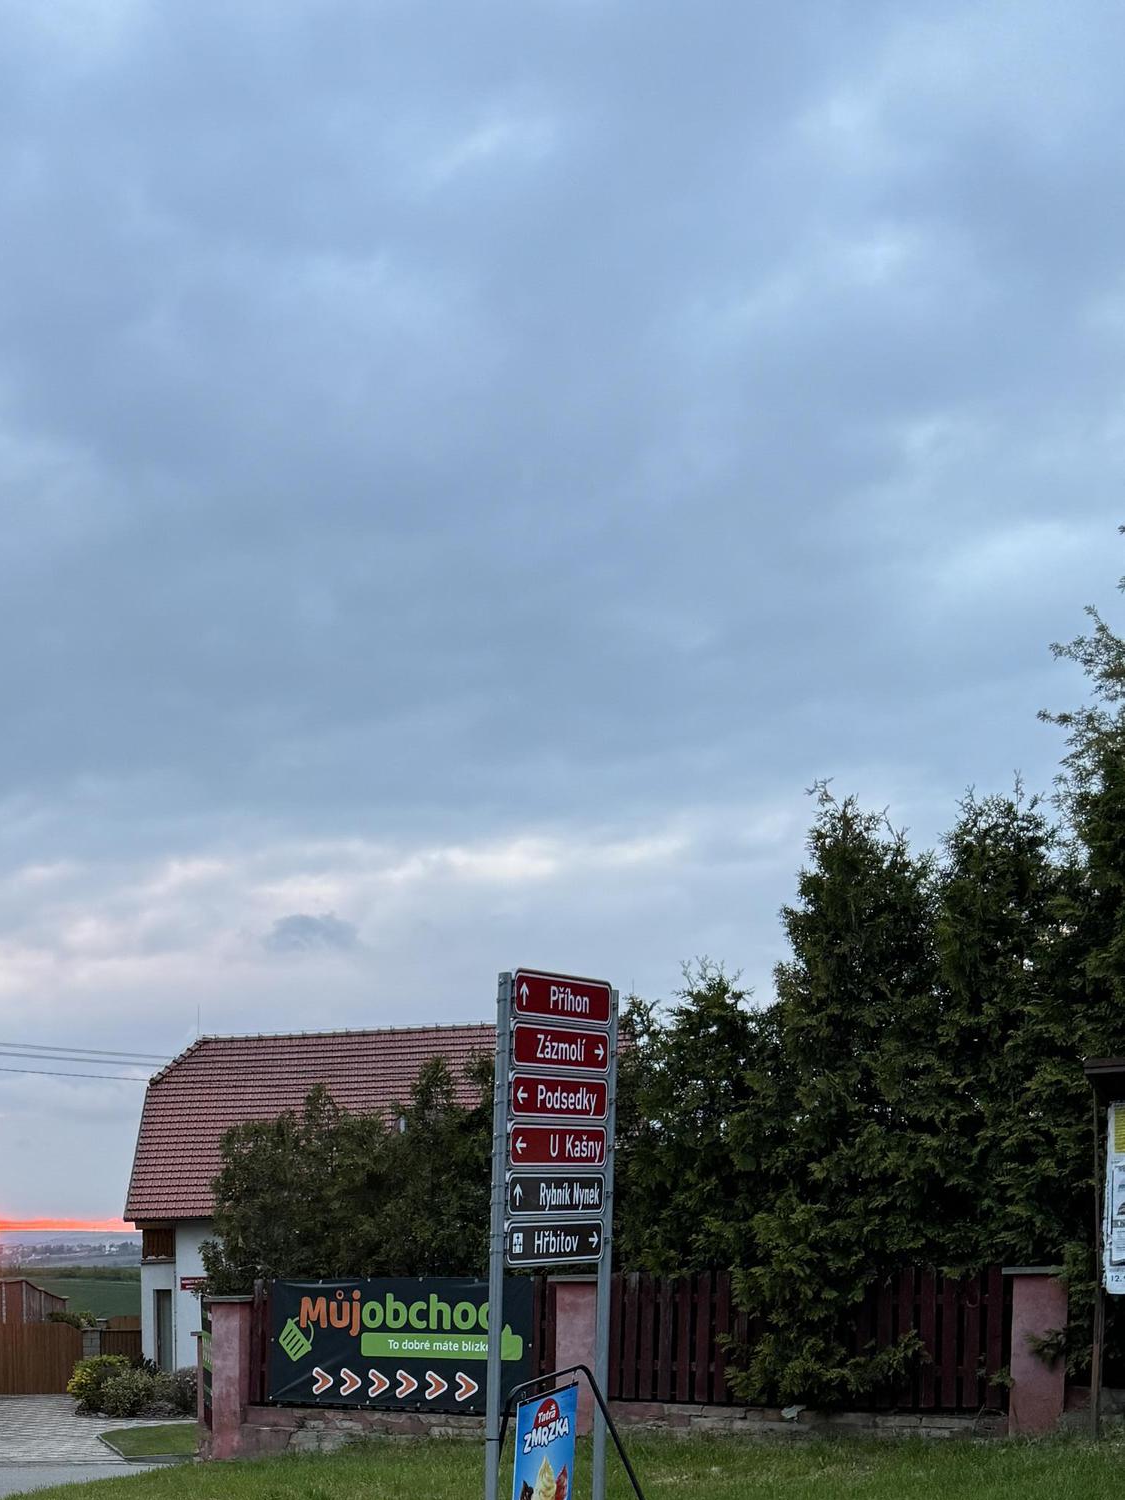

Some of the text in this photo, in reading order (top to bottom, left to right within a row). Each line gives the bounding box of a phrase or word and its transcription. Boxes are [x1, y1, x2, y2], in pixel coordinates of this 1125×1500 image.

[550, 986, 590, 1014] Příhon
[536, 1034, 586, 1062] Zázmolí
[537, 1084, 597, 1116] Podsedky
[550, 1134, 602, 1163] U Kašny
[539, 1182, 600, 1211] Rybník Nynek
[534, 1230, 579, 1254] Hřbitov
[388, 1339, 400, 1350] To
[401, 1339, 431, 1350] dobré
[433, 1340, 459, 1351] máte
[523, 1416, 570, 1454] ZMRZKA
